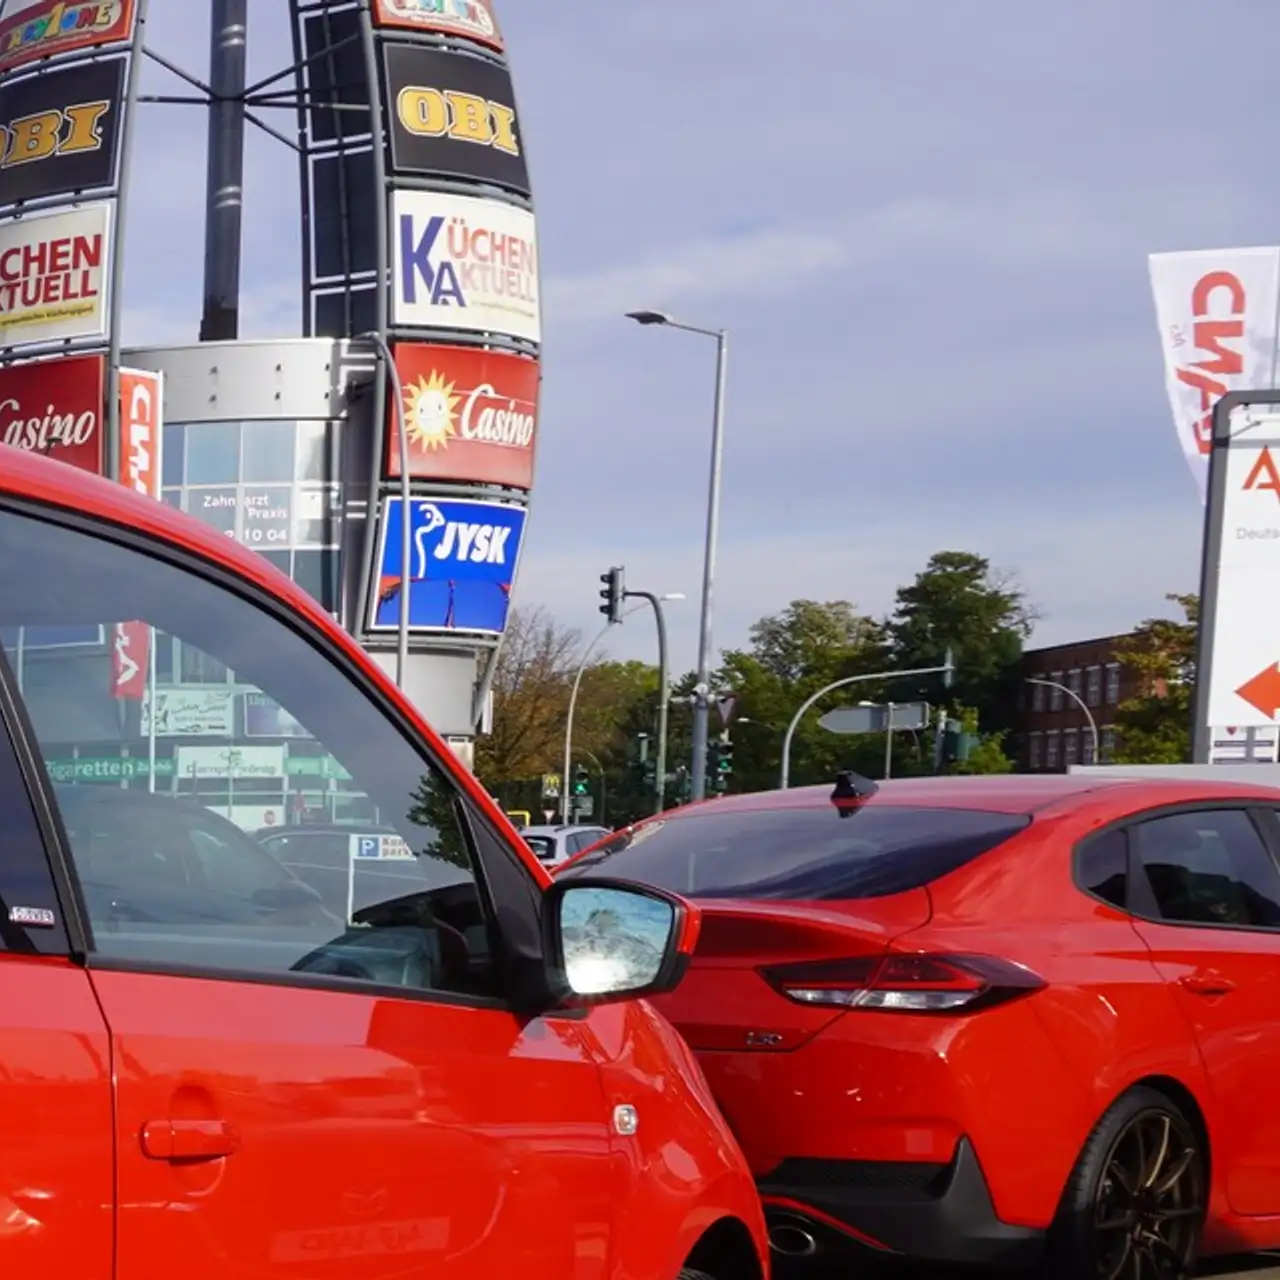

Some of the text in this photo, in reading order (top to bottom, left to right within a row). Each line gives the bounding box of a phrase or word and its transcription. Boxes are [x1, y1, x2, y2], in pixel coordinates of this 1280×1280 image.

[396, 86, 519, 156] OBI
[400, 214, 536, 304] KÜCHEN
[431, 261, 537, 307] AKTUELL
[460, 384, 534, 446] Casino
[247, 507, 288, 520] Praxis
[433, 521, 512, 565] JYSK
